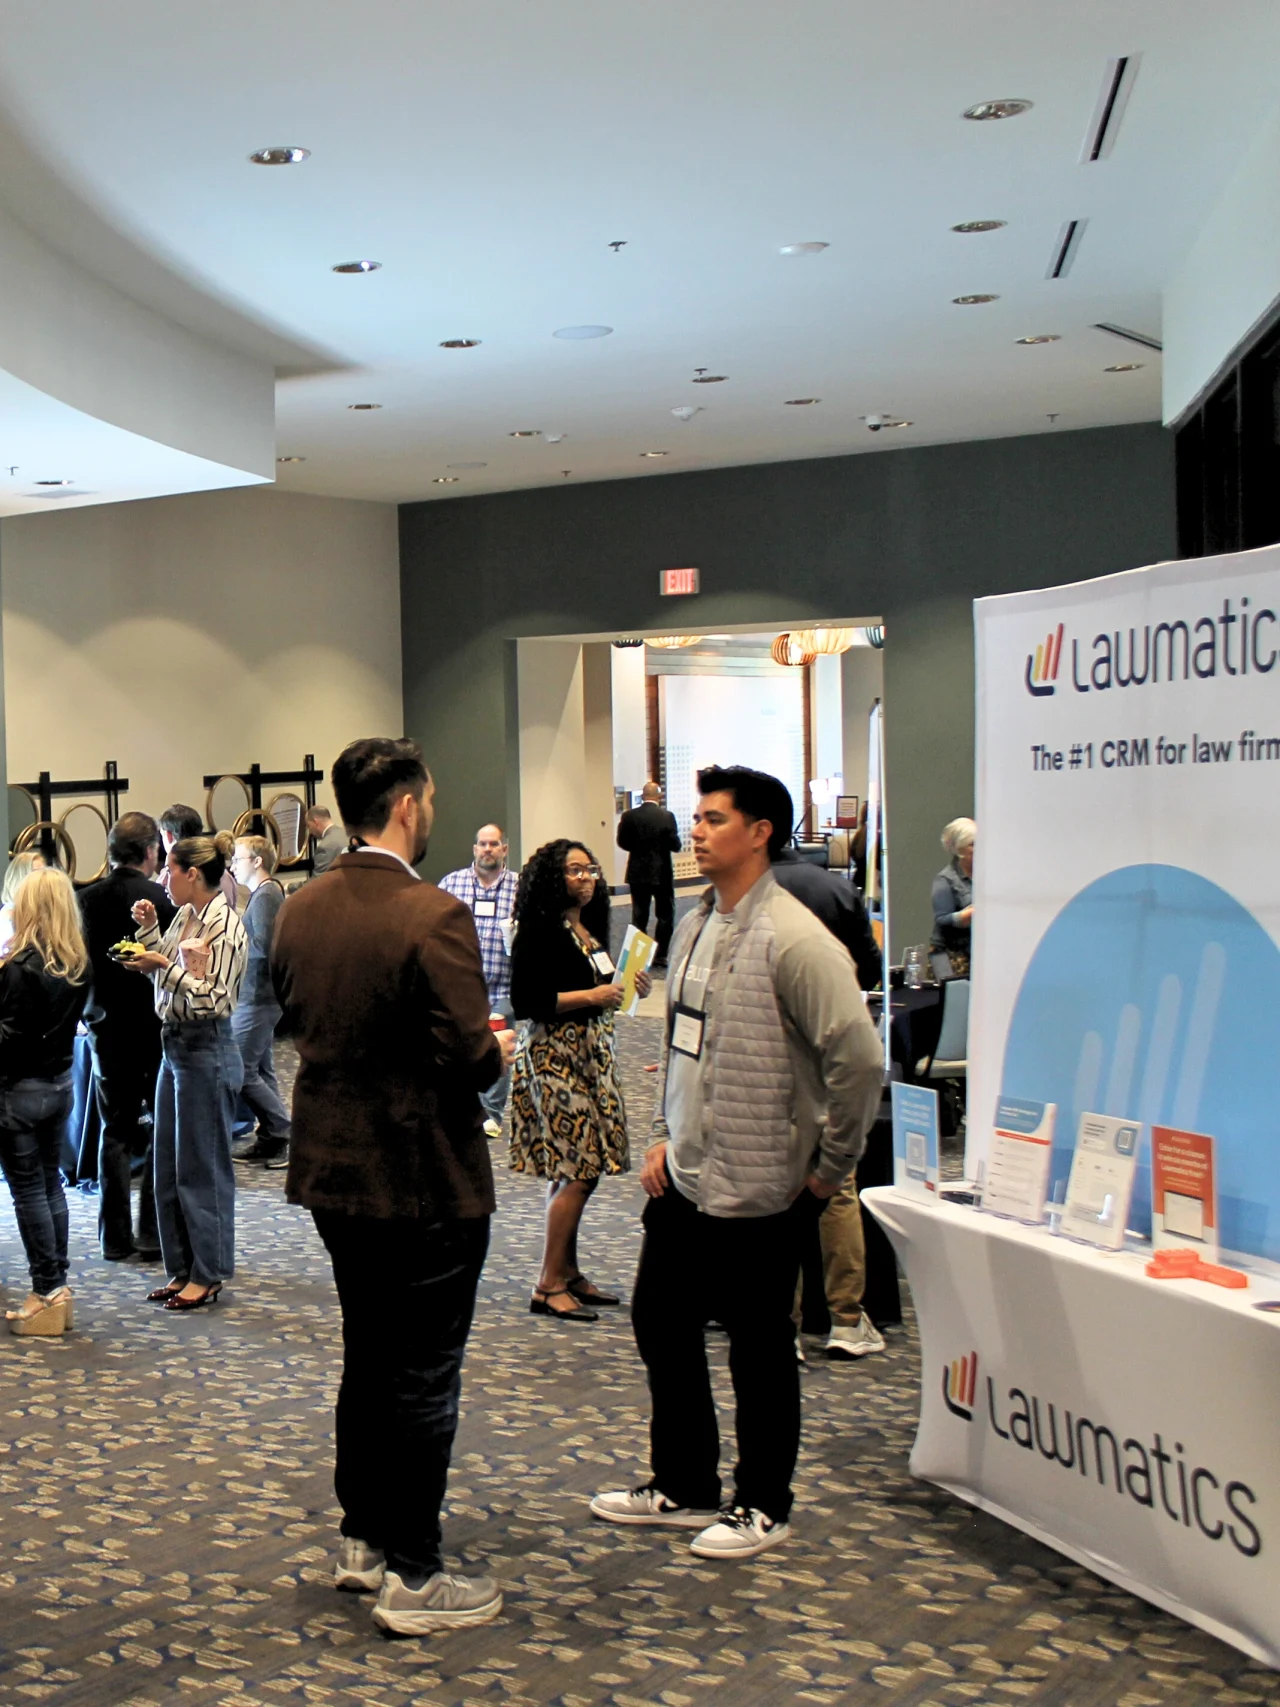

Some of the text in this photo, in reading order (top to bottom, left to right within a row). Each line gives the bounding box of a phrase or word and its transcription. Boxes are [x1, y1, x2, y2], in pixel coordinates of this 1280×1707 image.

[667, 569, 693, 592] EXIT
[1071, 596, 1280, 693] Lawmatic
[1030, 745, 1063, 771] The
[1068, 742, 1092, 769] #1
[1100, 738, 1148, 767] CRM
[1156, 736, 1186, 765] for
[1192, 733, 1232, 763] law
[986, 1376, 1261, 1558] Lawmatics
